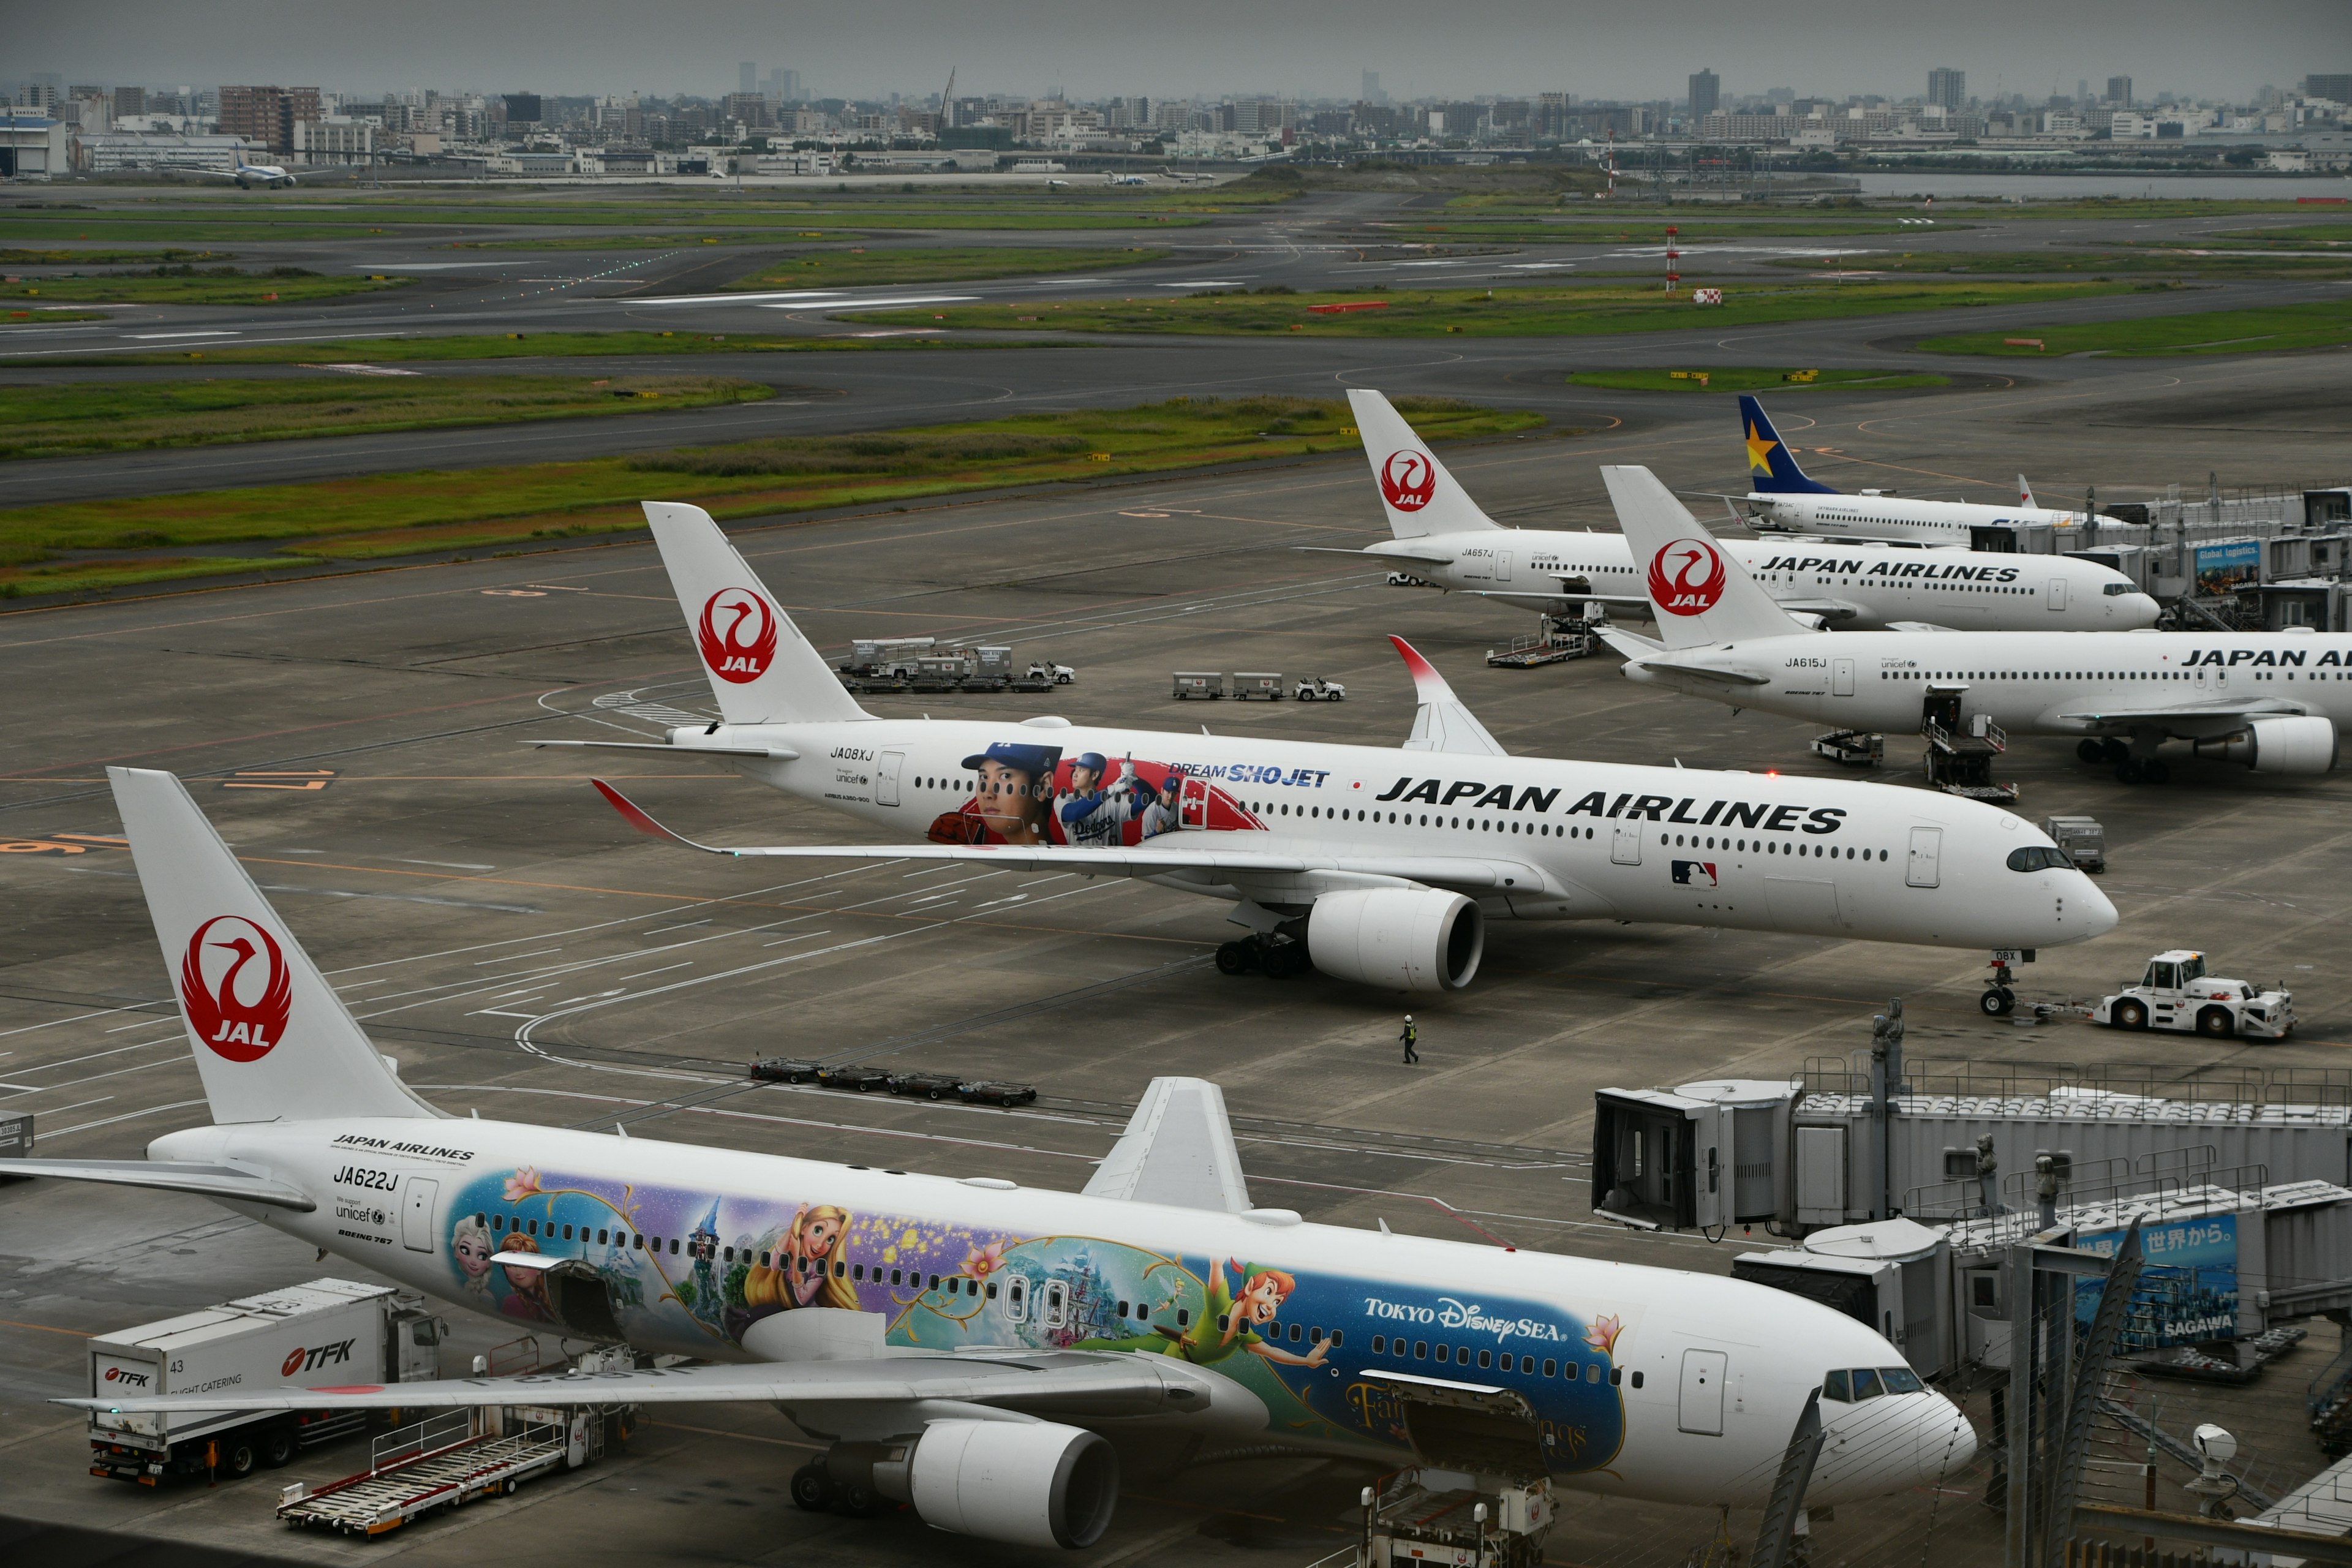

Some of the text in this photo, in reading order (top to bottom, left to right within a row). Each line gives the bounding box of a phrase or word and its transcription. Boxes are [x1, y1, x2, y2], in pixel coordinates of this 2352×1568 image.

[1395, 494, 1425, 505] JAL
[1462, 549, 1493, 557] JA657J
[2200, 546, 2258, 559] Global logistics.
[1760, 557, 2020, 582] JAPAN AIRLINES
[1668, 594, 1709, 606] JAL
[719, 655, 761, 673] JAL
[1785, 658, 1826, 668] JA615J
[2181, 650, 2307, 666] JAPAN
[831, 747, 874, 761] JA08XJ
[836, 773, 859, 784] unicef
[1168, 763, 1330, 788] DREAM SHO JET
[1376, 777, 1847, 834] JAPAN AIRLINES
[1074, 815, 1115, 840] Dodgers
[1996, 951, 2016, 960] 08X
[212, 1020, 269, 1047] JAL
[333, 1134, 475, 1160] JAPAN AIRLINES
[334, 1166, 399, 1191] JA622J
[336, 1205, 371, 1222] unicef
[338, 1229, 393, 1245] BOEING 767
[2147, 1224, 2230, 1253] 世界から。
[1364, 1297, 1434, 1324] TOKYO
[2164, 1314, 2233, 1338] SAGAWA
[304, 1338, 356, 1371] TFK
[170, 1360, 183, 1374] 43
[118, 1371, 149, 1387] TFK
[201, 1374, 241, 1393] CATERING
